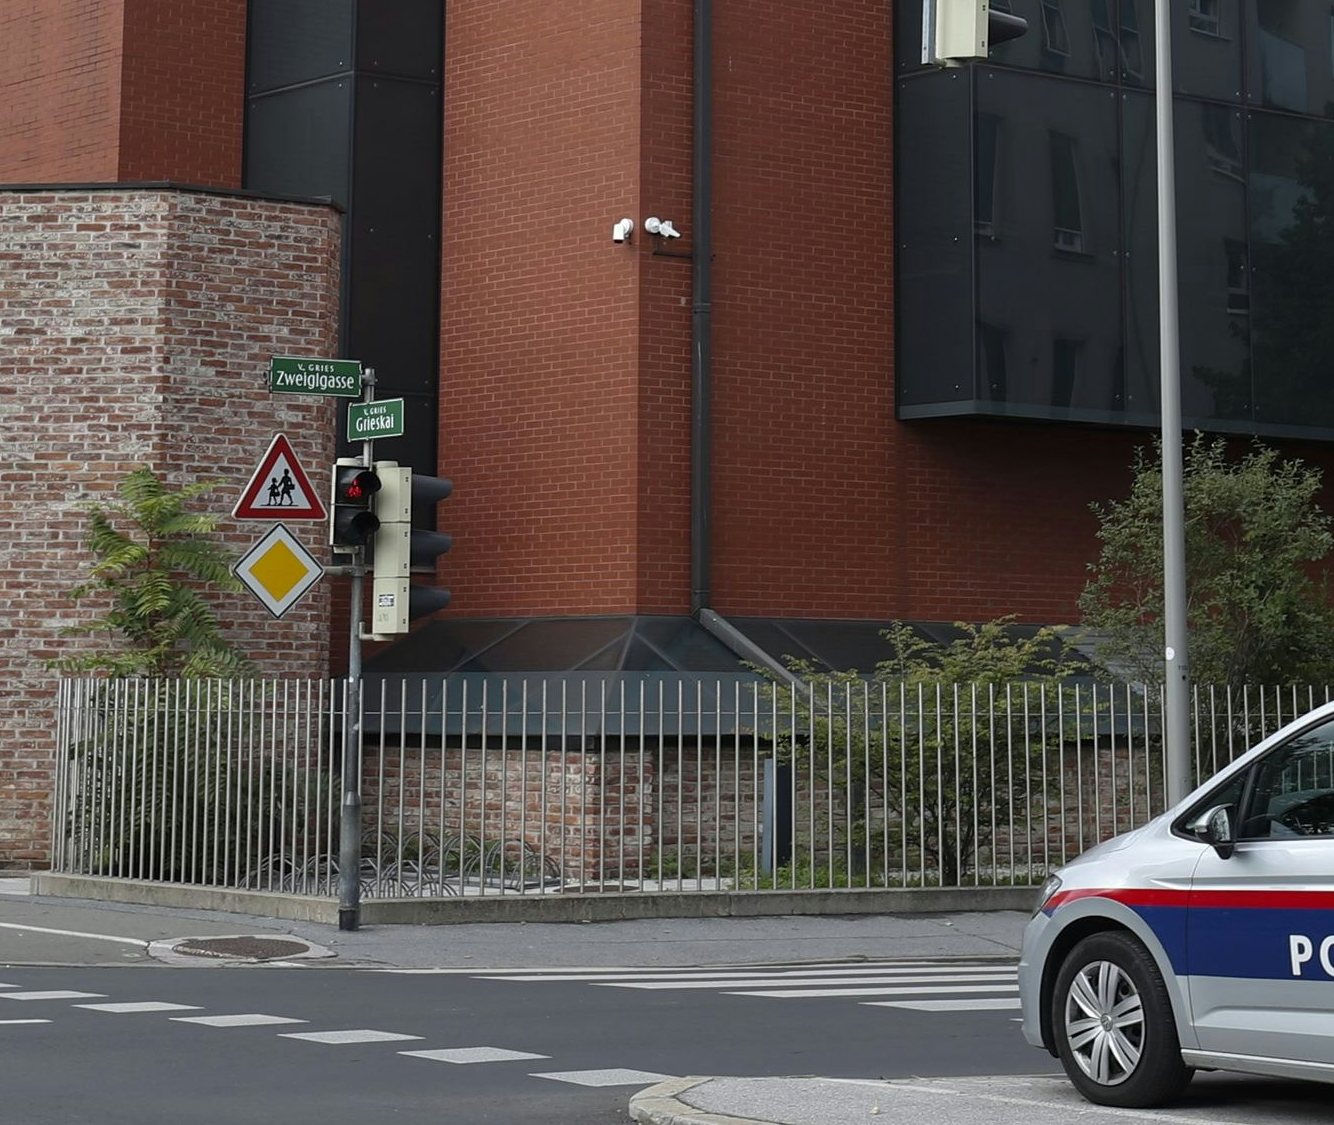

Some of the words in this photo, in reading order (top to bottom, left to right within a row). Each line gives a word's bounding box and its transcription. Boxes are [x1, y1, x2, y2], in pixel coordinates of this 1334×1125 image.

[308, 363, 335, 372] GRIES
[276, 370, 355, 391] Zweiglgasse
[370, 406, 387, 414] GRIES
[356, 414, 394, 432] Grieskai
